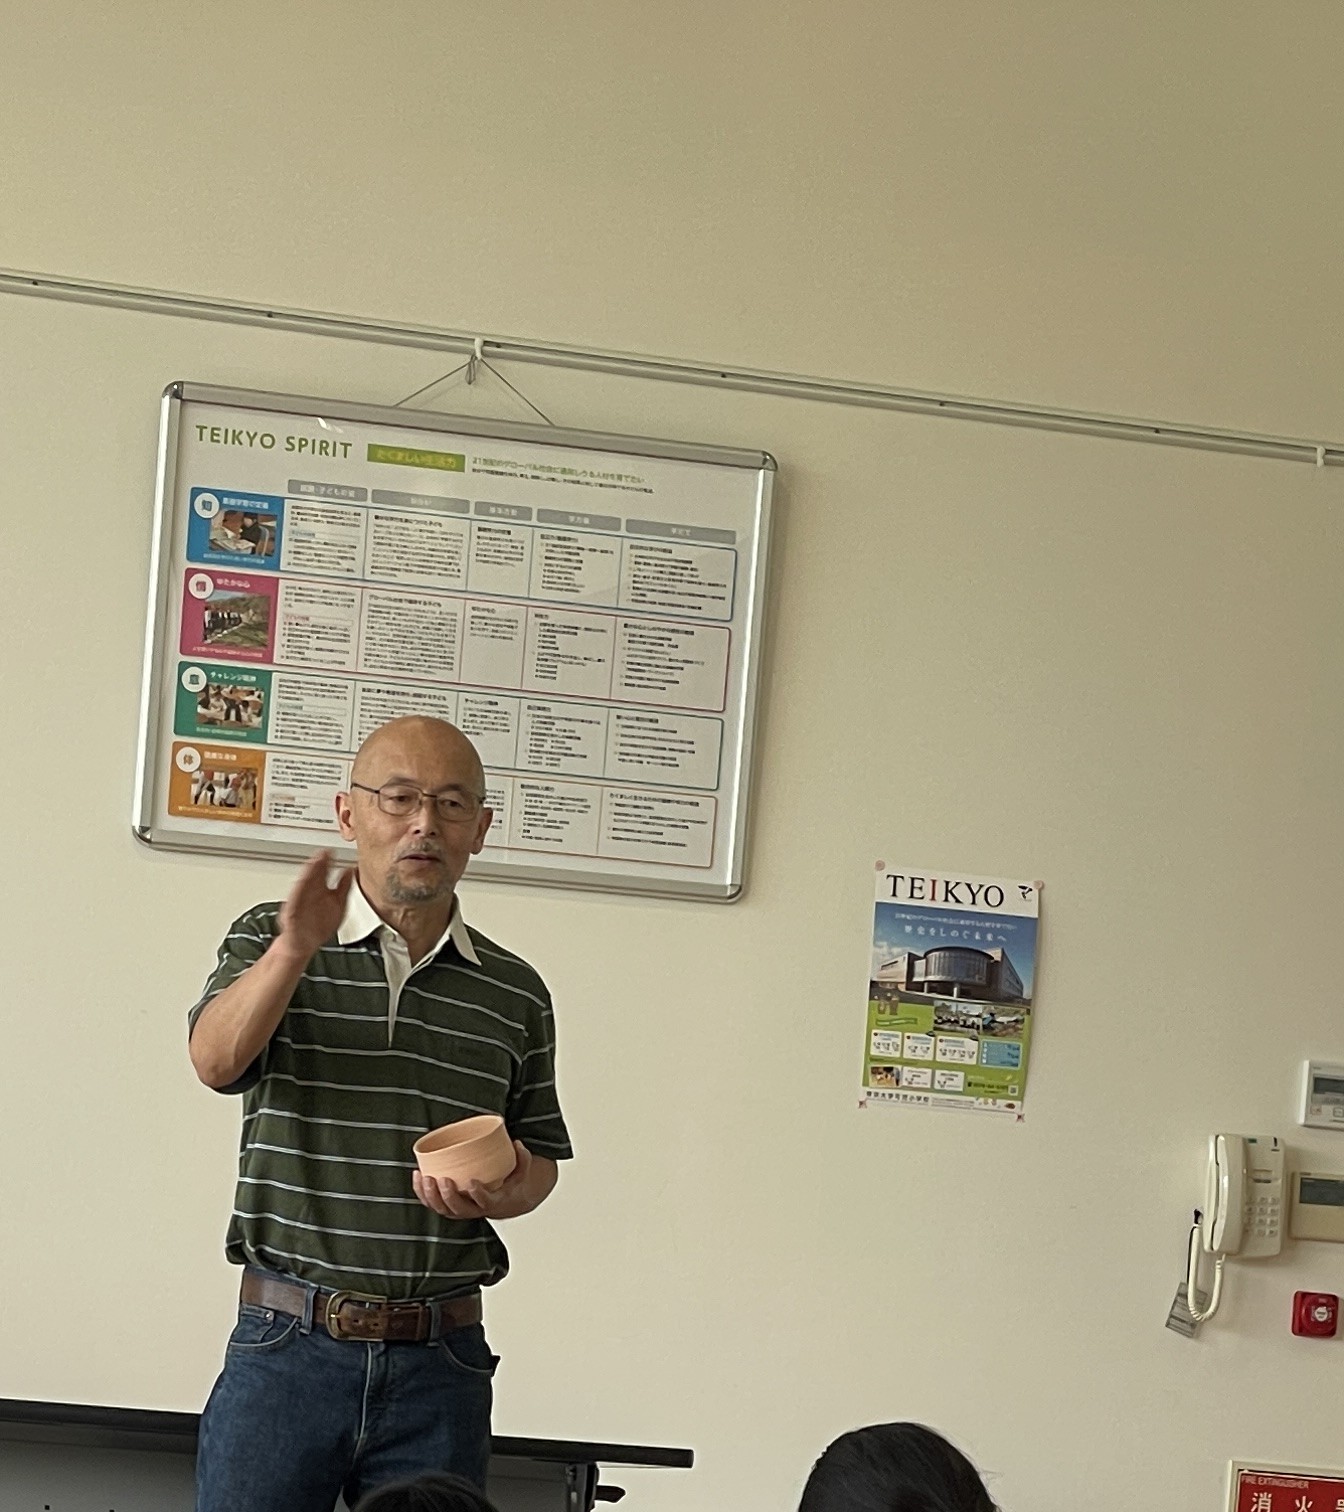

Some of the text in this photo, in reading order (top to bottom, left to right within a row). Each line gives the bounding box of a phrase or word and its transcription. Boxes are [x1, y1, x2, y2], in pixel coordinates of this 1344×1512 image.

[195, 424, 353, 459] TEIKYO SPIRIT
[886, 873, 1005, 908] TEIKYO
